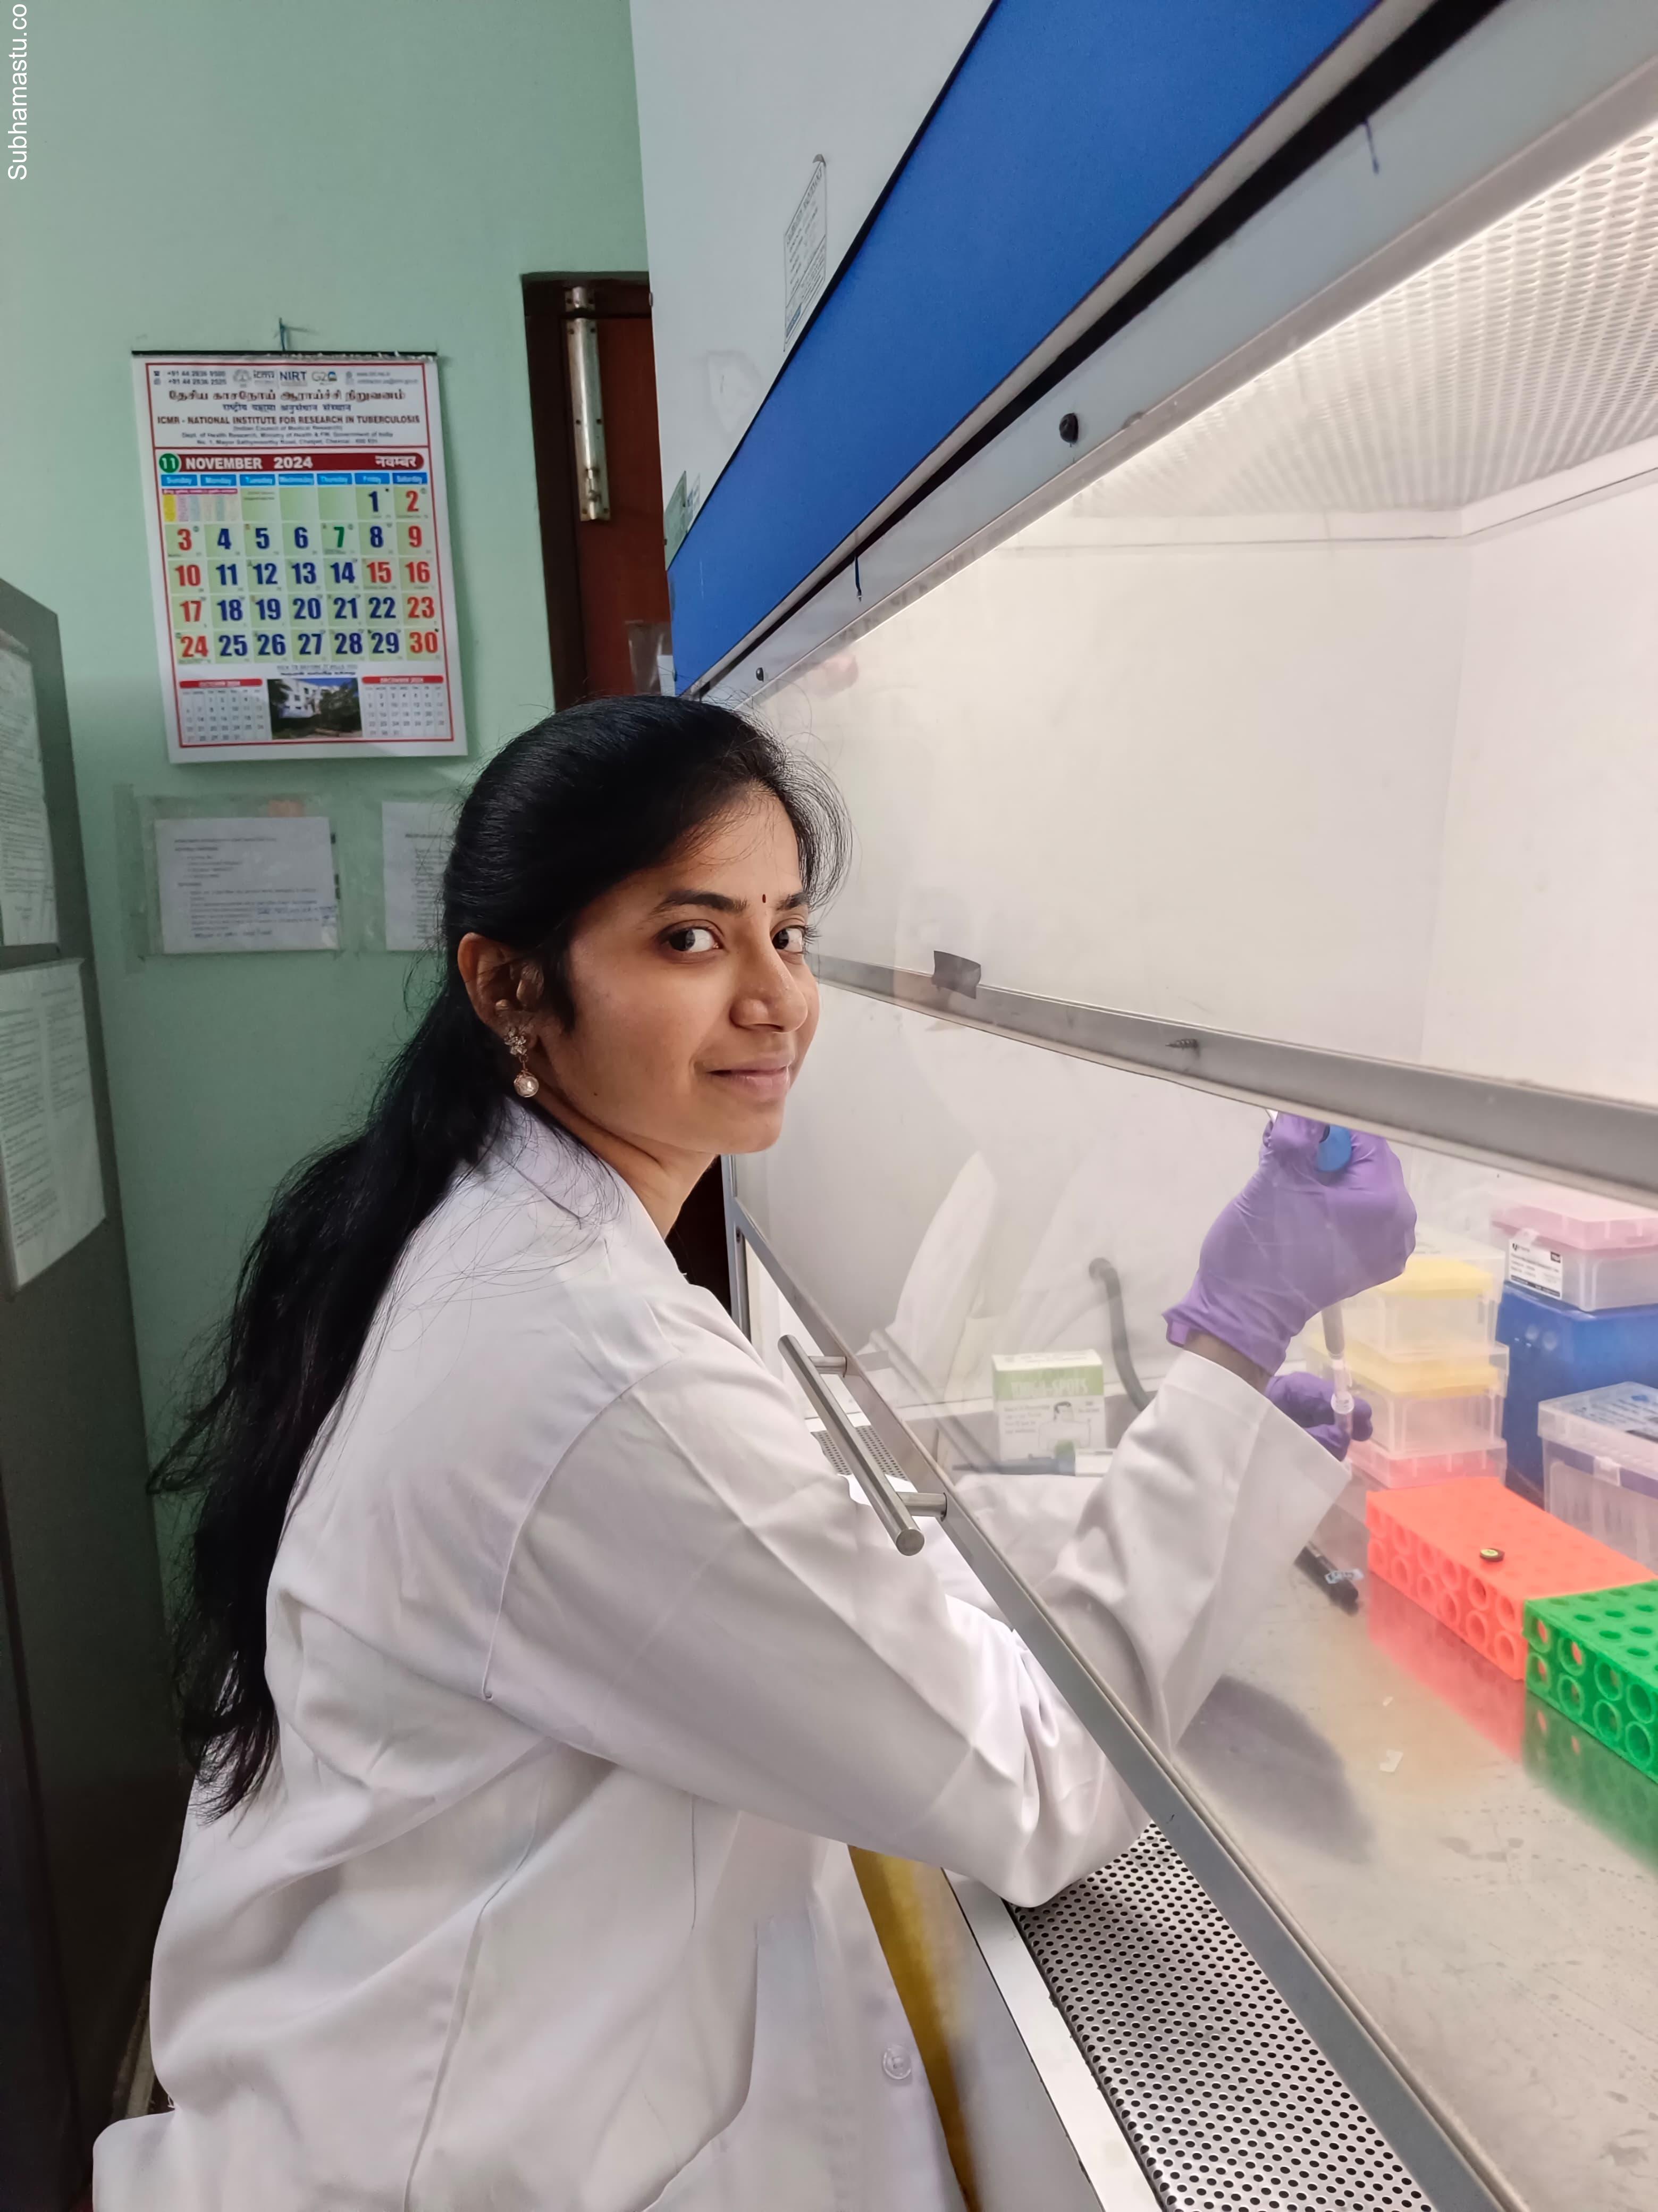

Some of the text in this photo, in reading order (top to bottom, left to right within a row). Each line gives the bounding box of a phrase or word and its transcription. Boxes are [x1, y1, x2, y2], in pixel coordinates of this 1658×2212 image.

[280, 371, 307, 381] NIRT
[357, 415, 420, 423] TUBERCULOSIS
[161, 456, 313, 470] 11 NOVEMBER 2024
[375, 455, 417, 467] नवम्बर
[368, 490, 419, 513] 1 2
[177, 525, 422, 551] 3 4 5 6 7 8 9
[175, 561, 431, 587] 10 11 12 13 14 15 16
[180, 596, 435, 622] 17 18 19 20 21 22 23
[180, 632, 438, 658] 24 25 26 27 28 29 30
